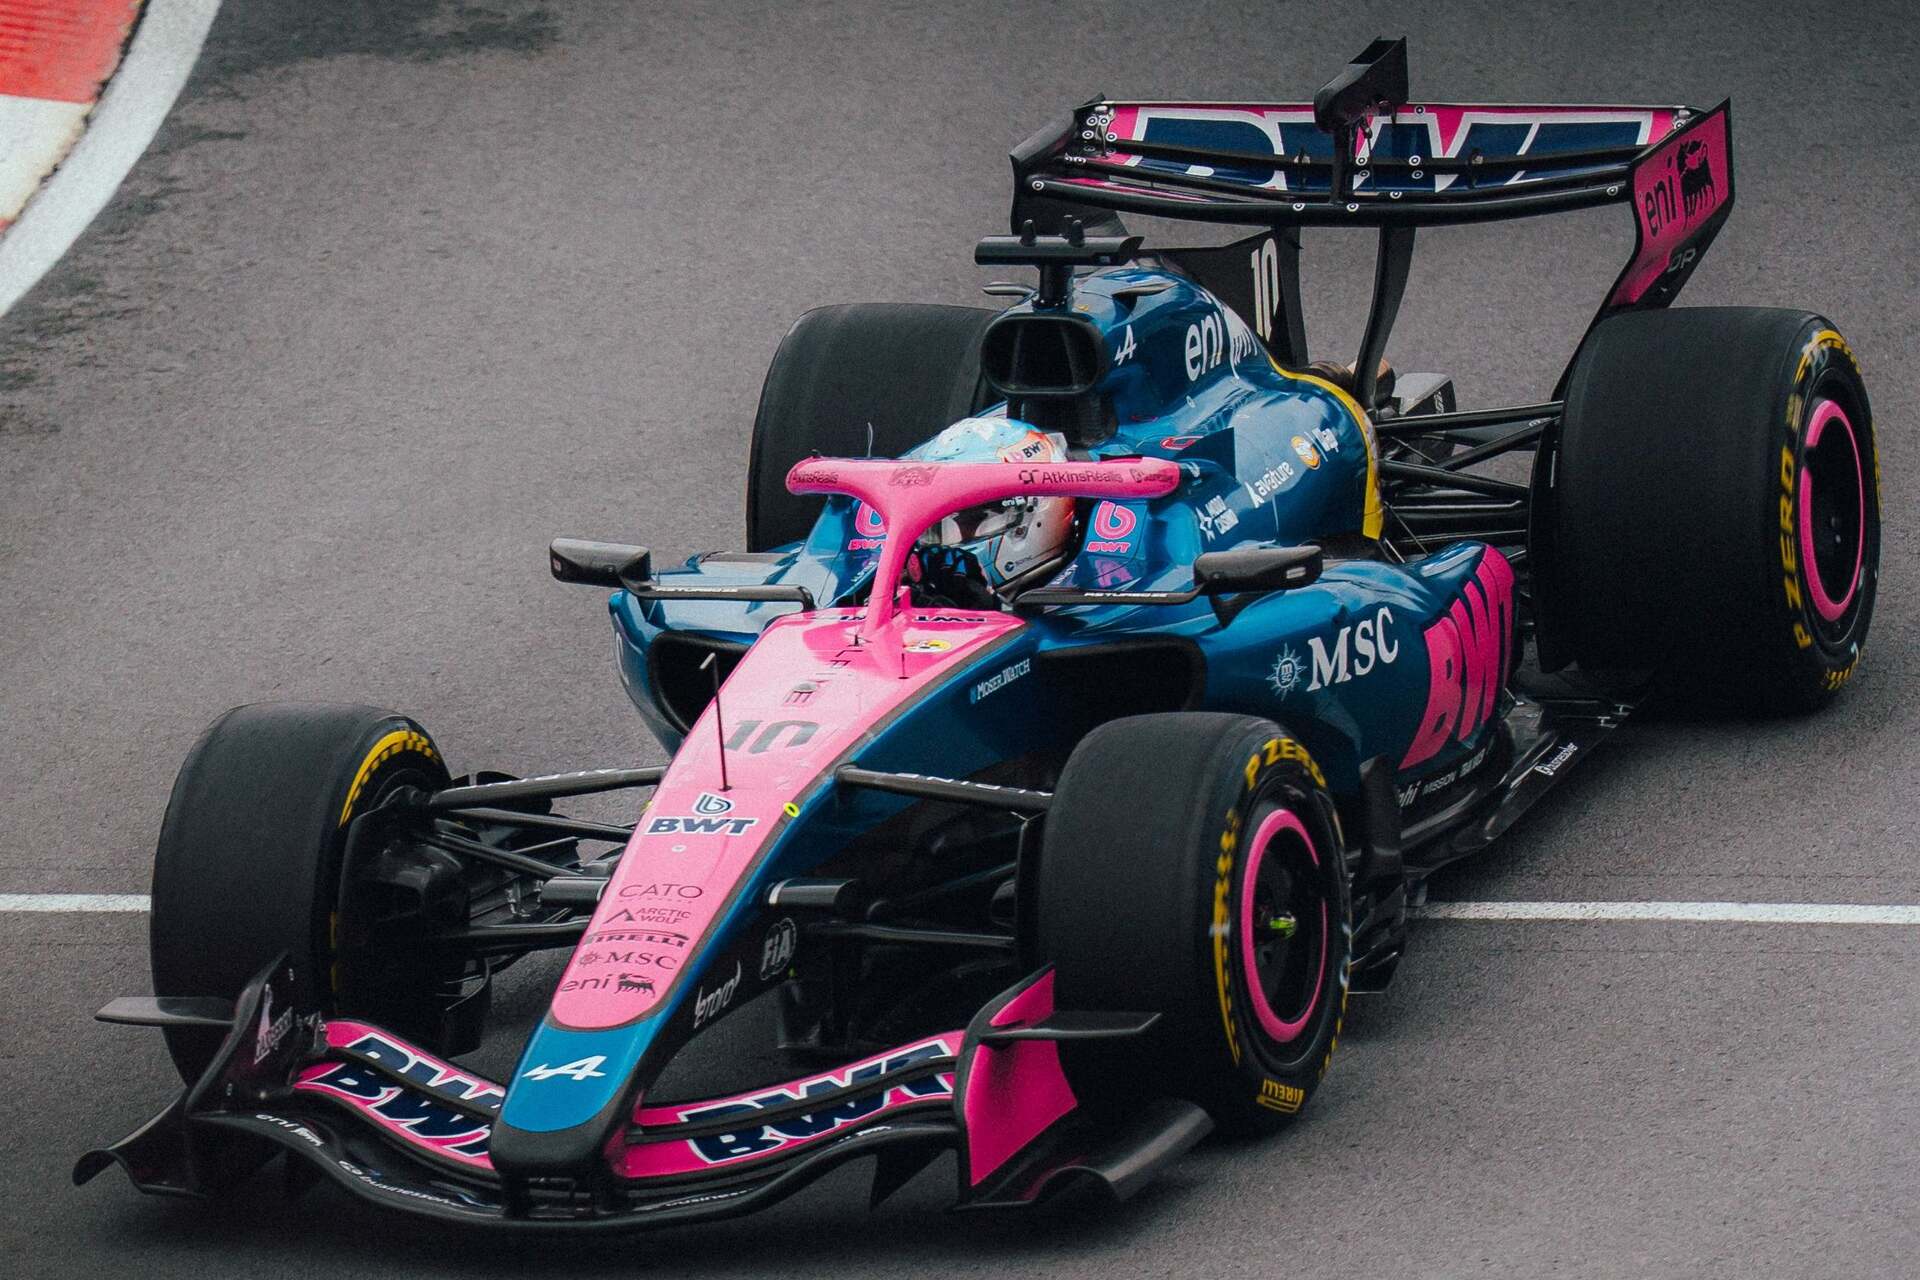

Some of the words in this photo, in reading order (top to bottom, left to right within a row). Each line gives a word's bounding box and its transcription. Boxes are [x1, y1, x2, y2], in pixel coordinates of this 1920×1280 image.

[1644, 154, 1677, 238] eni
[1250, 237, 1280, 342] 10
[1185, 311, 1223, 382] eni
[1086, 540, 1132, 553] BWT
[1306, 606, 1399, 692] MSC
[721, 719, 820, 755] 10
[645, 816, 757, 836] BWT
[618, 884, 704, 900] CATO
[636, 907, 693, 920] ARCTIC
[603, 951, 678, 971] MSC
[760, 928, 791, 974] FIA
[559, 973, 610, 993] eni
[255, 1114, 299, 1128] eni
